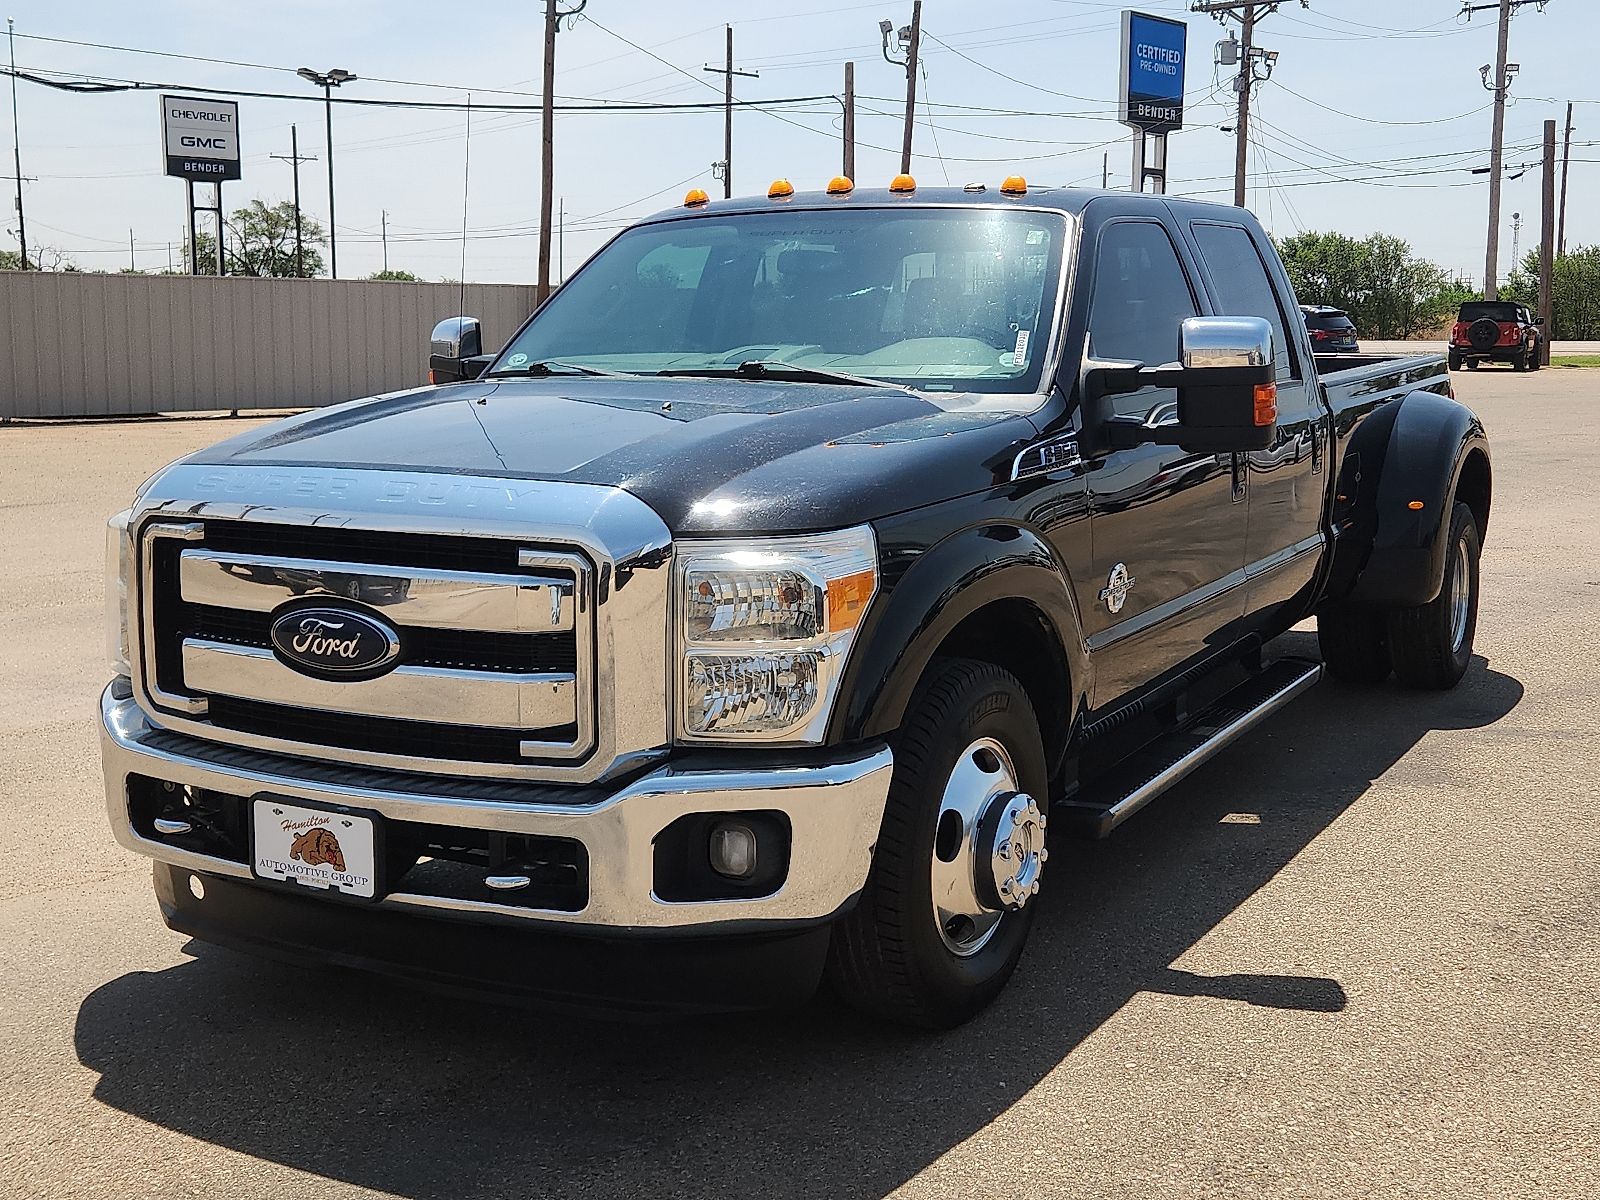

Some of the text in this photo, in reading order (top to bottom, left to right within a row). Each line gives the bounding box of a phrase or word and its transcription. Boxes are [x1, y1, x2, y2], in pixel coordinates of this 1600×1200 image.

[1136, 43, 1180, 64] CERTIFIED
[1140, 60, 1177, 76] PRE-OWNED
[171, 109, 232, 122] CHEVROLET
[1138, 103, 1176, 121] BENDER
[180, 136, 226, 149] GMC
[184, 162, 225, 174] BENDER
[194, 471, 543, 509] SUPER DUTY
[292, 617, 362, 659] Ford
[280, 815, 332, 832] Hamilton
[259, 859, 328, 878] AUTOMOTIVE
[330, 872, 369, 886] GROUP
